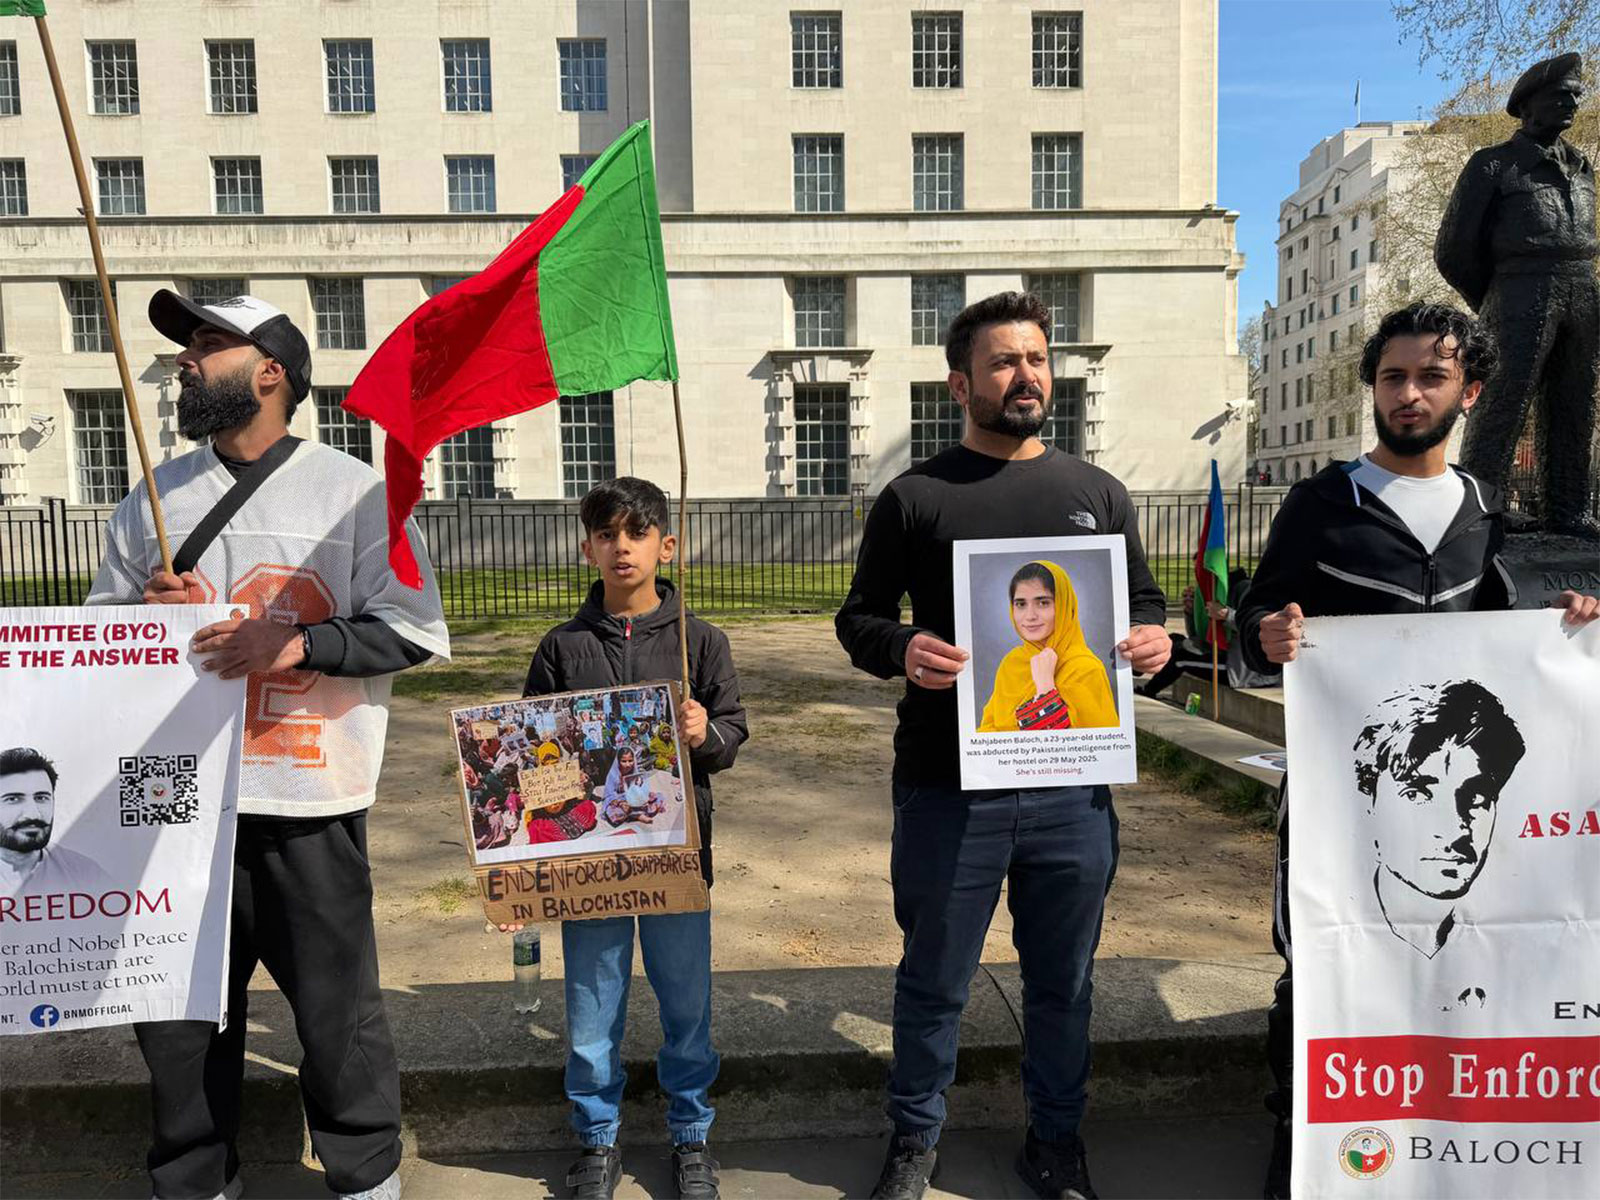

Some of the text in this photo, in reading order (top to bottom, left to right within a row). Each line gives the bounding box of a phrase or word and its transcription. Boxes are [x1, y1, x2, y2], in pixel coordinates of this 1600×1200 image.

[103, 622, 167, 644] (BYC)
[18, 650, 64, 668] THE
[71, 647, 179, 667] ANSWER
[971, 738, 1012, 746] Mahjabeen
[1014, 737, 1042, 745] Baloch,
[1021, 747, 1030, 755] by
[1032, 746, 1066, 754] Pakistani
[1061, 757, 1076, 765] May
[1518, 810, 1600, 838] ASA
[511, 891, 666, 920] IN BALOCHISTAN
[25, 937, 61, 956] and
[68, 932, 125, 952] Nobel
[133, 930, 188, 946] Peace
[5, 953, 154, 976] Balochistan are
[0, 971, 169, 996] orld must act now
[64, 1003, 133, 1019] BNMOFFICIAL
[1325, 1052, 1424, 1107] Stop
[1409, 1136, 1583, 1165] BALOCH
